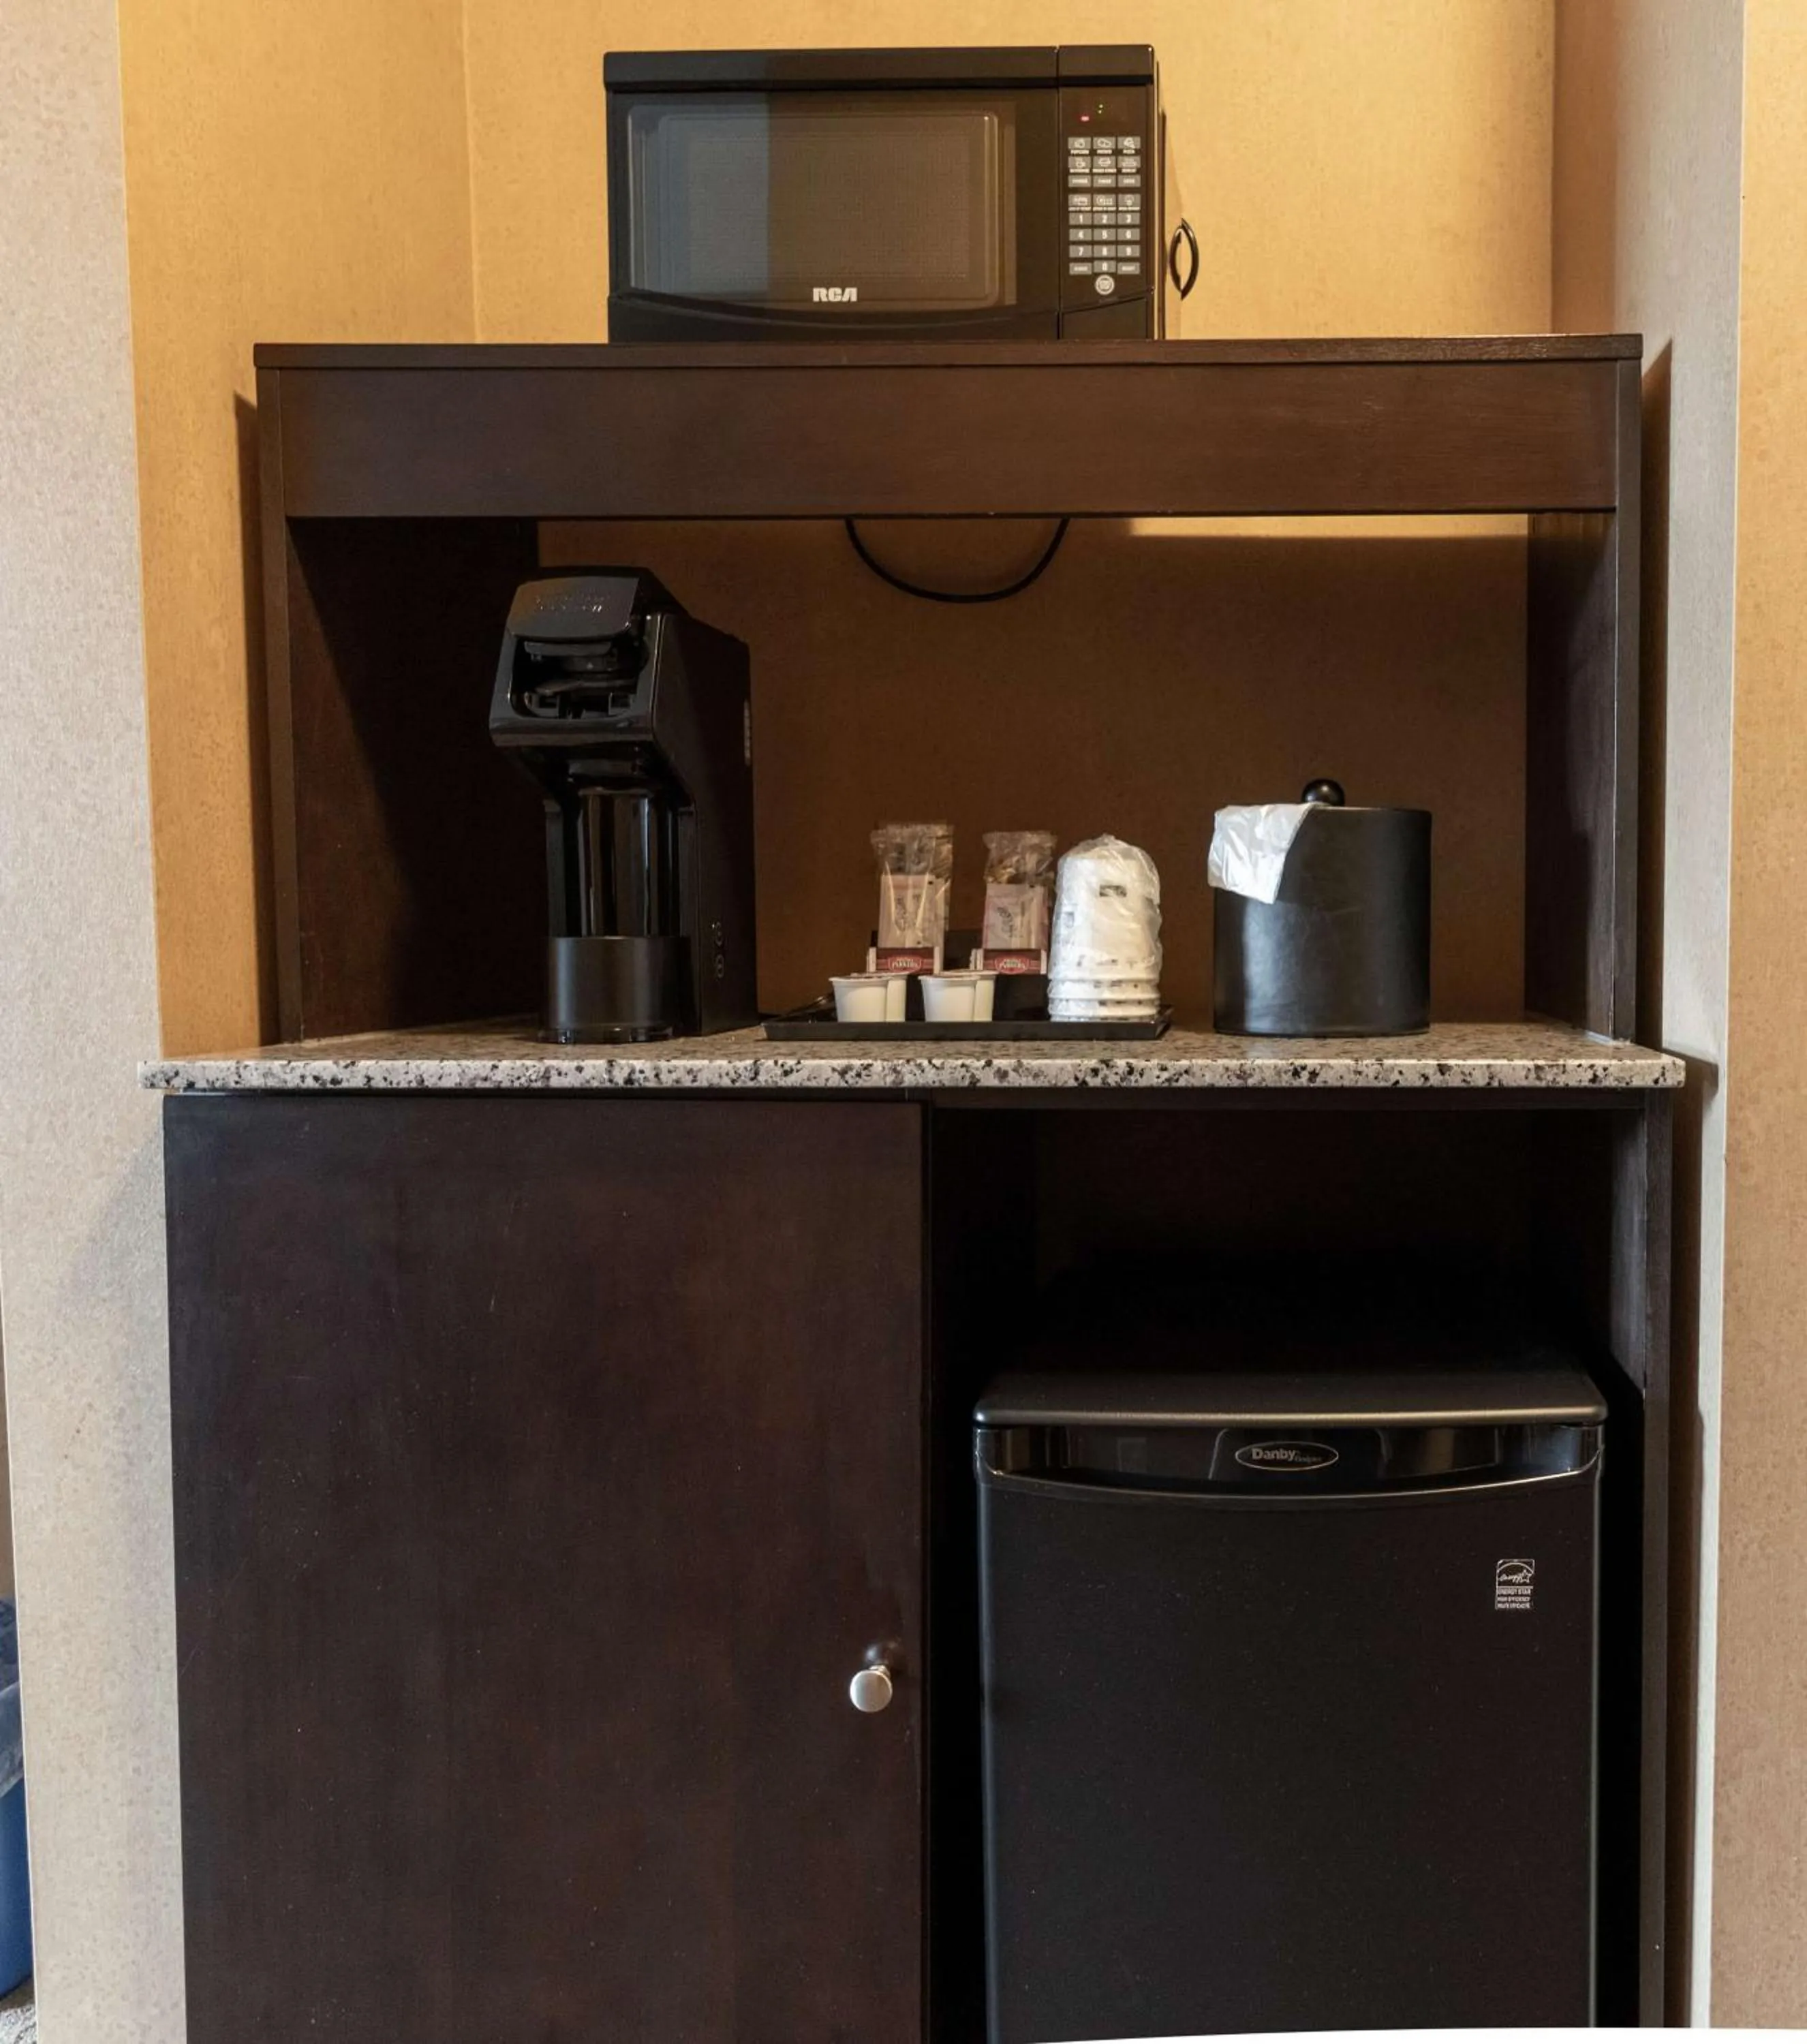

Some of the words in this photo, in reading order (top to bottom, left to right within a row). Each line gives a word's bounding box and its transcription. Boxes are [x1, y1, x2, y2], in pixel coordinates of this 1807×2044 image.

[1079, 214, 1083, 223] 1
[1102, 214, 1107, 223] 2
[1126, 214, 1132, 223] 3
[1079, 230, 1084, 239] 4
[1102, 230, 1107, 240] 5
[1079, 247, 1084, 256] 7
[1102, 247, 1107, 256] 8
[1102, 262, 1107, 271] 0
[813, 287, 858, 302] RCA
[1252, 1448, 1295, 1461] Danby
